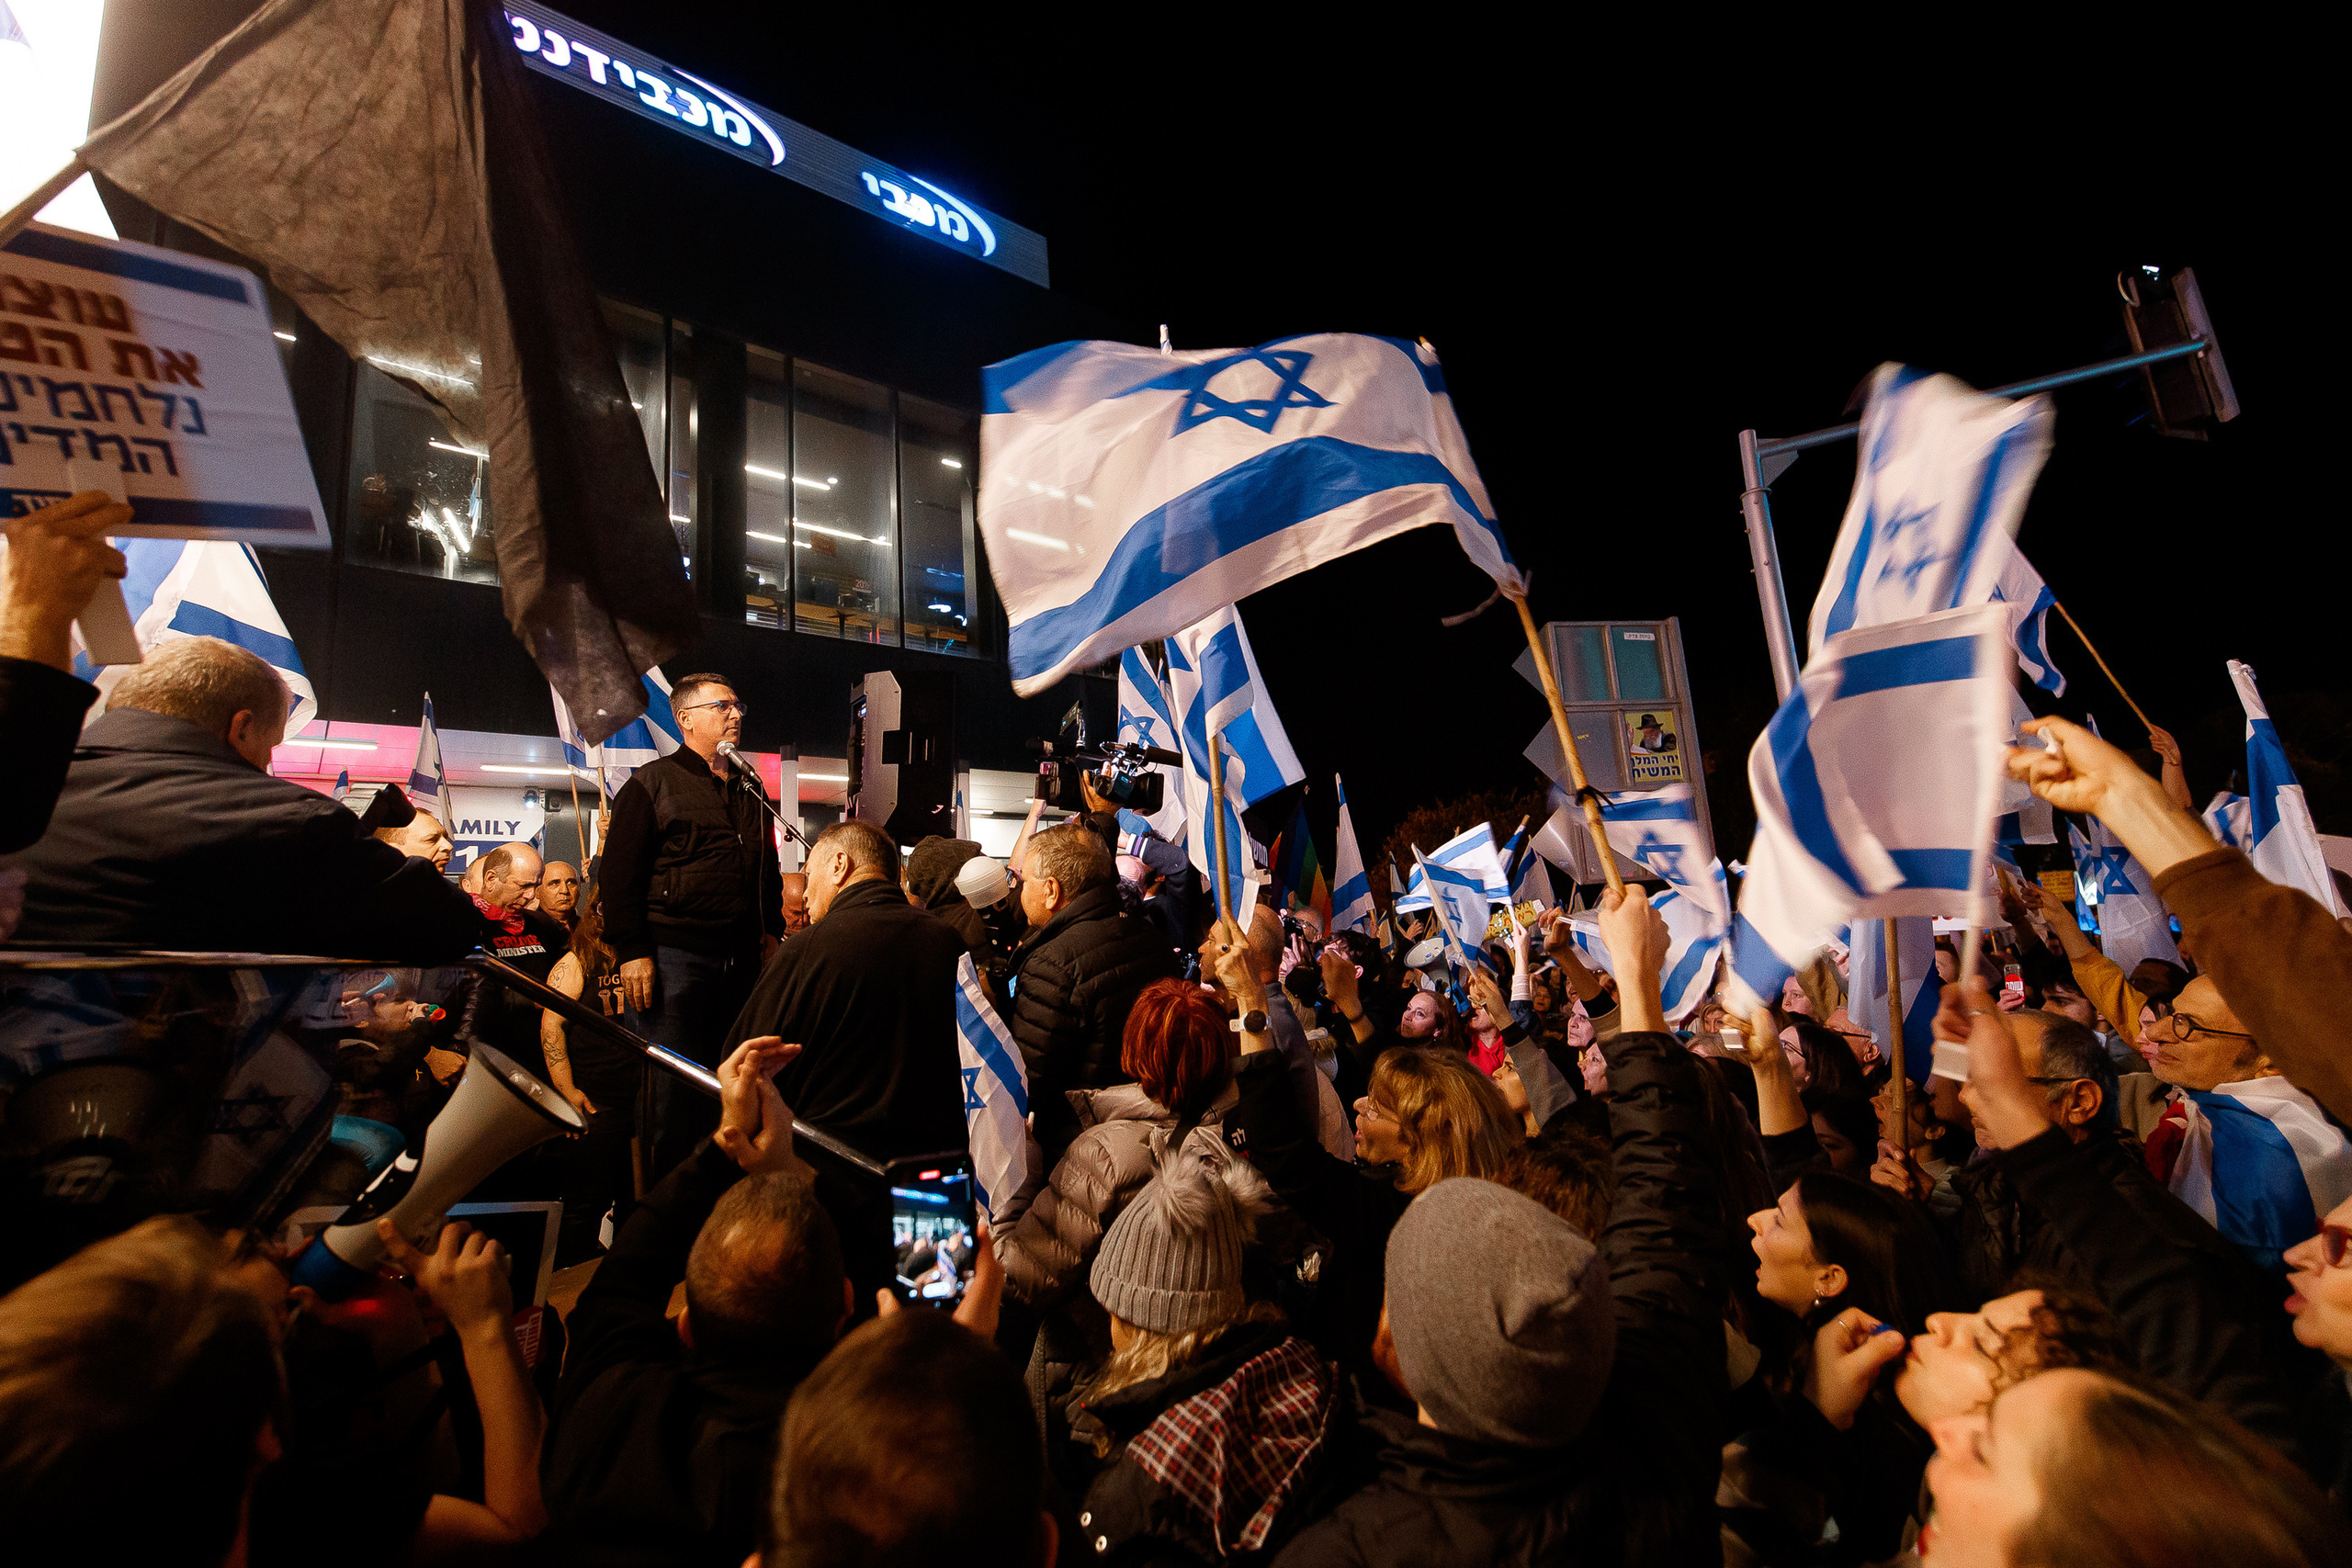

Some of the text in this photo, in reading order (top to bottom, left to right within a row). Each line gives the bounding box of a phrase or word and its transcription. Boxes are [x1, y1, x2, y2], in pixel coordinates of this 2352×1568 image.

[861, 171, 969, 243] מכבי
[0, 274, 133, 333] עוצ
[107, 338, 204, 389] את
[1662, 755, 1678, 763] יחי
[1632, 765, 1680, 778] המשיח
[492, 934, 541, 948] CRIME
[496, 945, 546, 958] MINISTER
